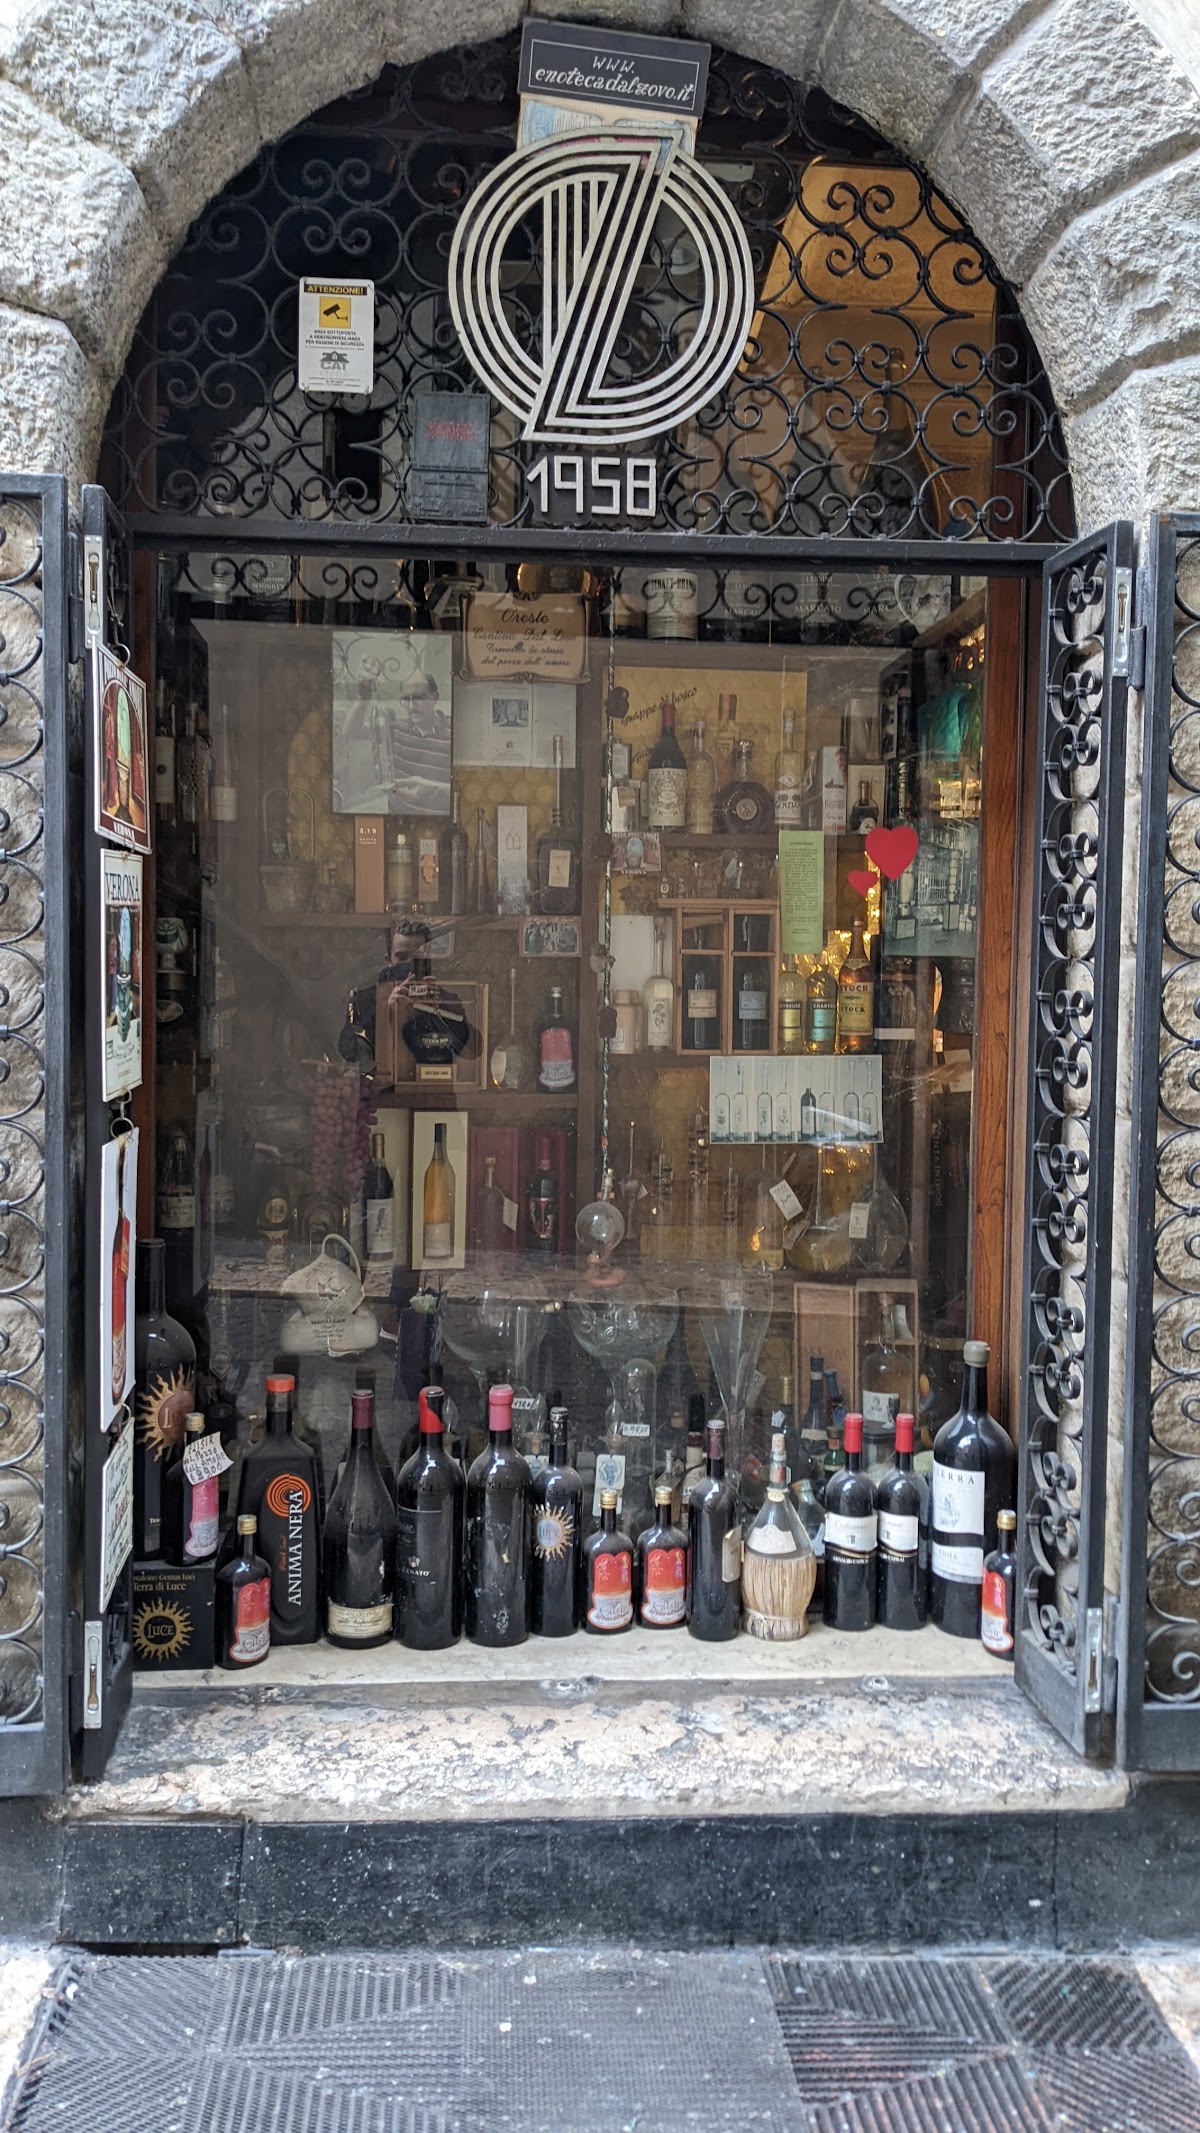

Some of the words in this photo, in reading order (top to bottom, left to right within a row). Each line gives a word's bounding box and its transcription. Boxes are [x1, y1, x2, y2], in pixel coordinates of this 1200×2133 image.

[535, 67, 695, 101] enotecadalzovo.it
[307, 284, 364, 295] ATTENZIONE!
[527, 455, 657, 517] 1958
[501, 609, 550, 624] Oreste
[795, 604, 842, 614] MARCATO
[473, 627, 516, 641] Cantina
[105, 872, 140, 901] VERONA
[933, 1468, 975, 1485] IERRA
[289, 1490, 303, 1540] NERA
[288, 1542, 303, 1606] ANIMA
[402, 1566, 431, 1577] ZENATO
[155, 1581, 164, 1591] di
[166, 1581, 187, 1590] Luce
[147, 1623, 174, 1638] LUCE
